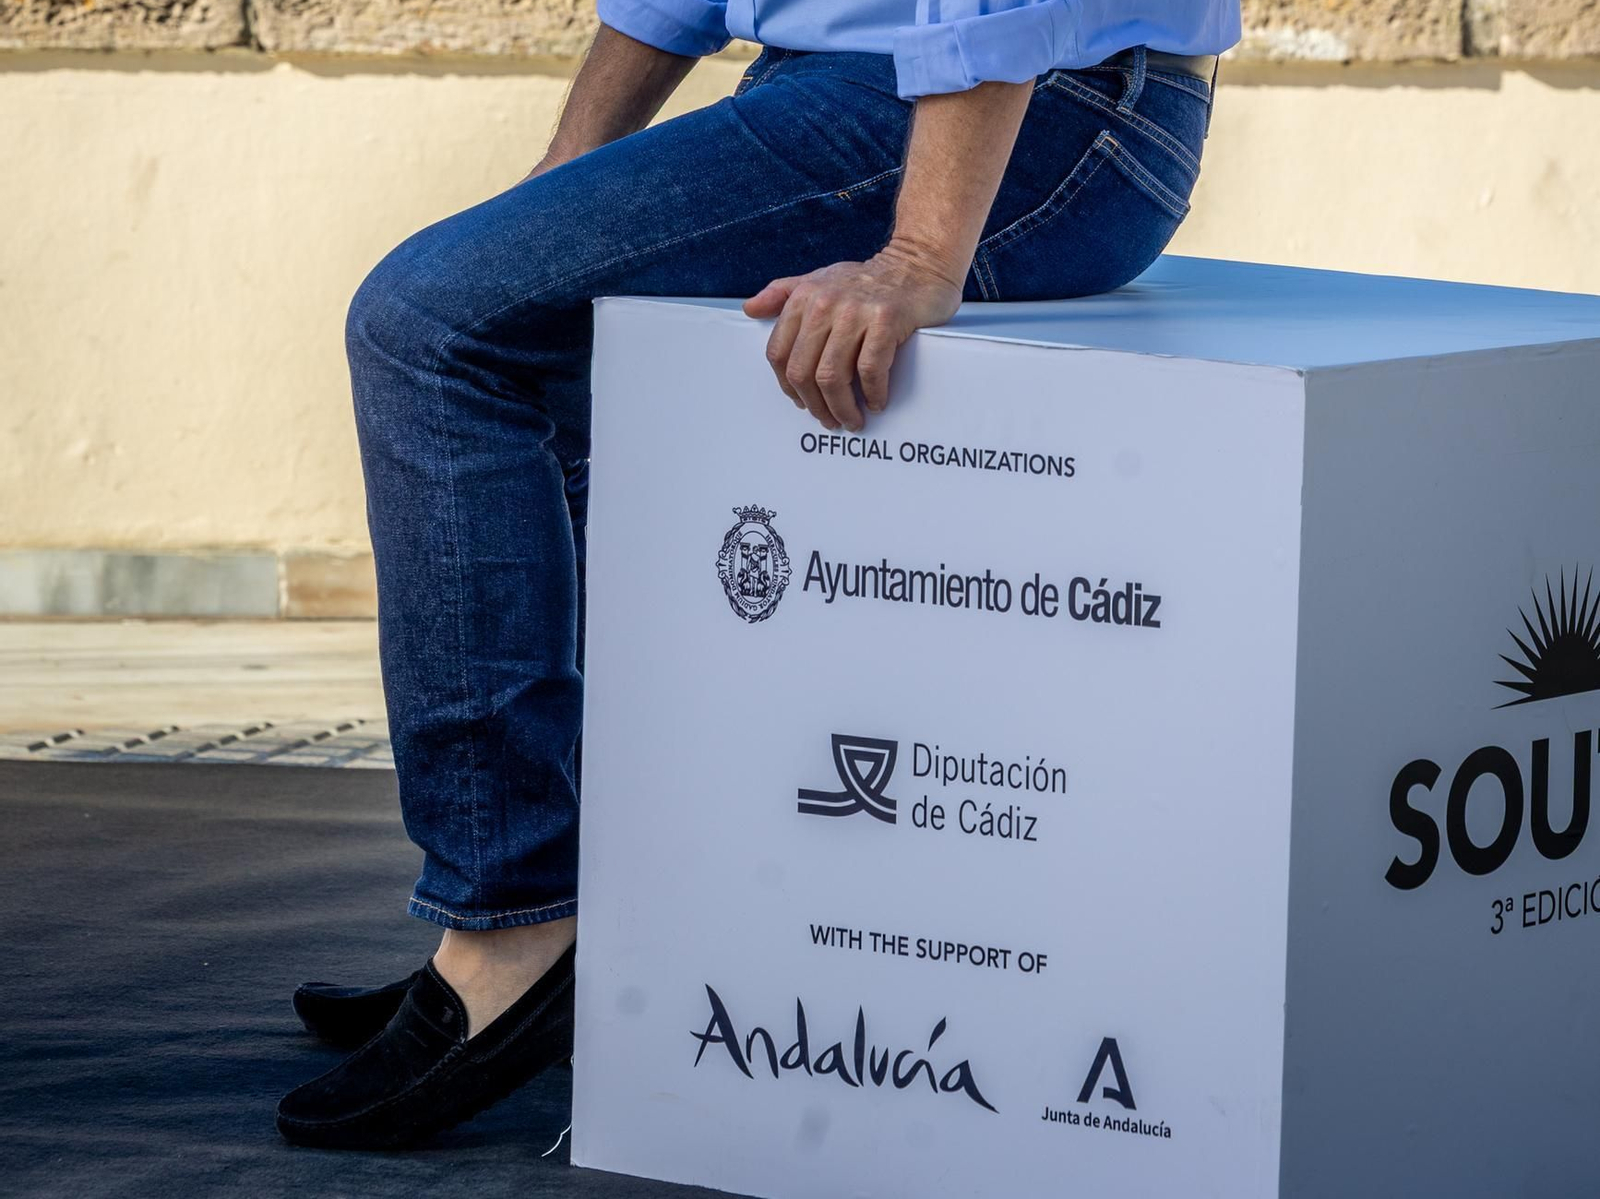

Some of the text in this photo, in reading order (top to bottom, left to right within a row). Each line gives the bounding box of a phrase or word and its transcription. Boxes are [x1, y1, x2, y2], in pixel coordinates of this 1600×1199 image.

[801, 432, 1076, 479] OFFICIAL ORGANIZATIONS
[803, 549, 1161, 629] Ayuntamiento de Cádiz
[912, 742, 1067, 795] Diputación
[911, 794, 1038, 842] de Cádiz
[1384, 727, 1600, 891] SOU
[809, 923, 1048, 975] WITH THE SUPPORT OF
[689, 982, 1000, 1115] Andalucía
[1040, 1106, 1172, 1140] Junta de Andalucía
